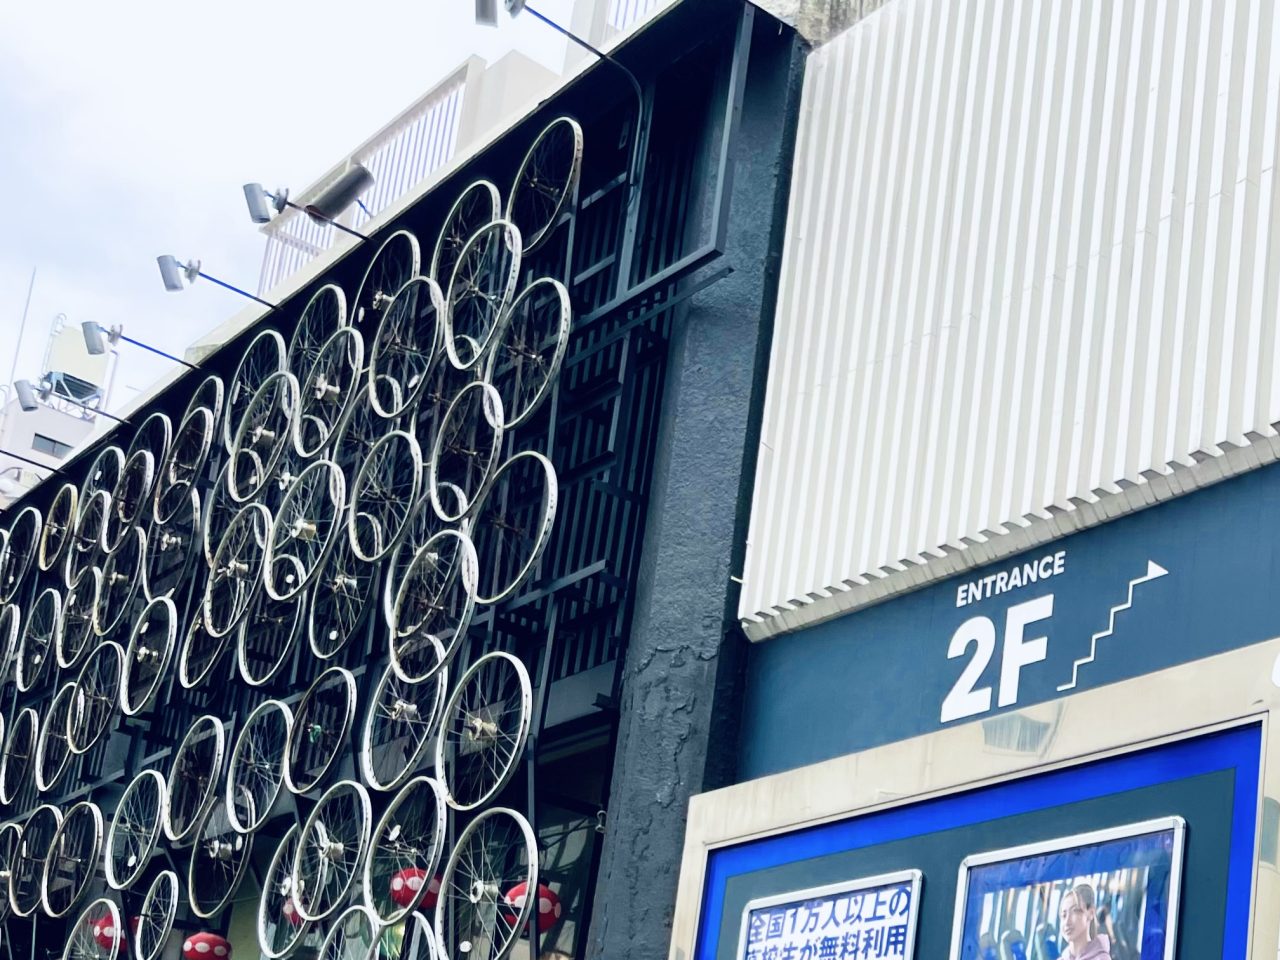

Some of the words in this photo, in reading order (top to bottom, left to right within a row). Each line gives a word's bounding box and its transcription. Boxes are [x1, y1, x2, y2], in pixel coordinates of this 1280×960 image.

[956, 551, 1066, 608] ENTRANCE
[940, 593, 1055, 723] 2F
[750, 886, 911, 944] 全国1万人以上の
